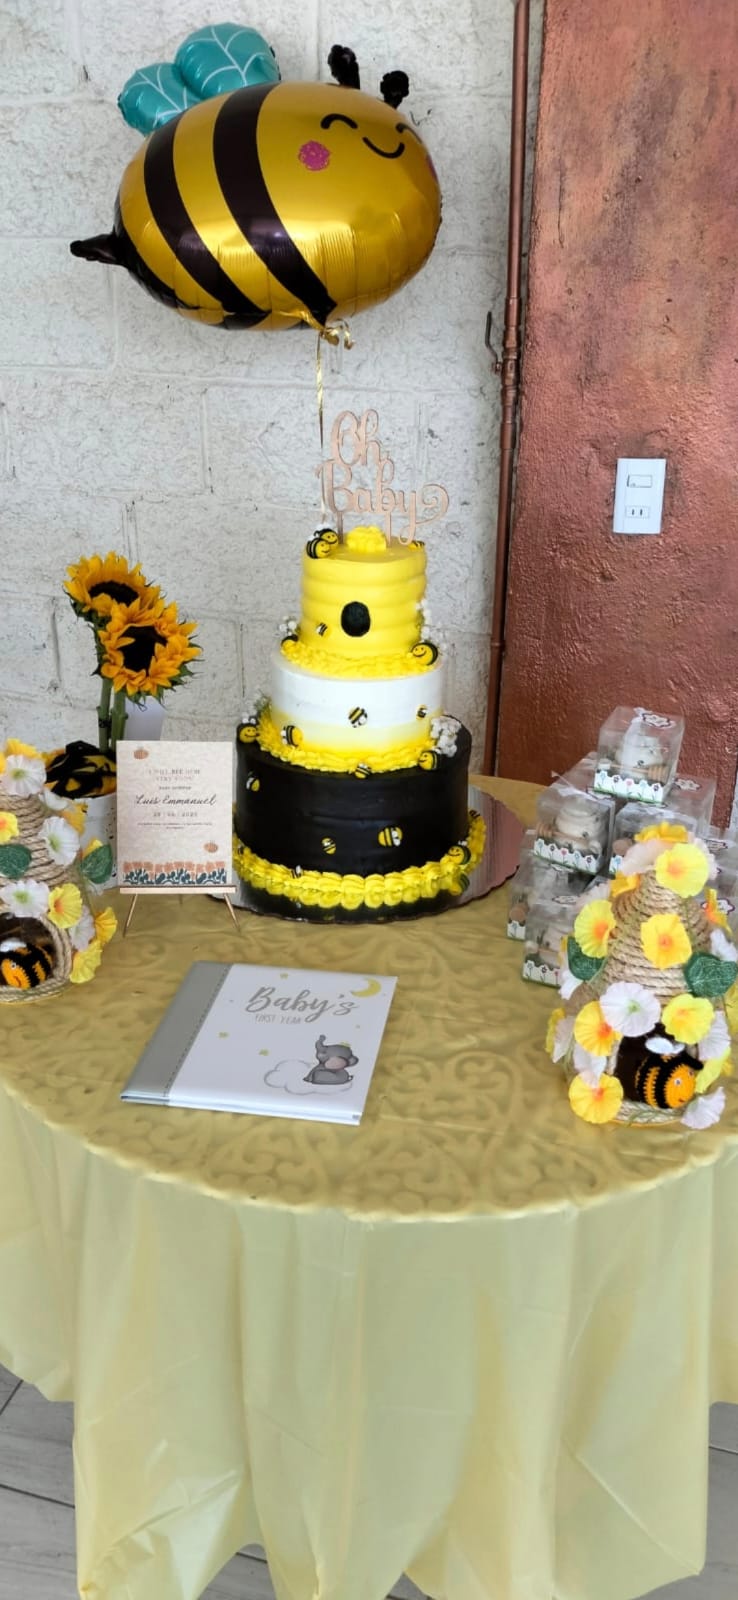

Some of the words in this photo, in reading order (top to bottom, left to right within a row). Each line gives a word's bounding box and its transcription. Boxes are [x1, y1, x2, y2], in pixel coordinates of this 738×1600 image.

[331, 409, 381, 467] Oh
[314, 458, 449, 545] Baby
[136, 794, 160, 805] Luis
[162, 794, 216, 806] Emmanuel
[245, 986, 359, 1023] Baby's
